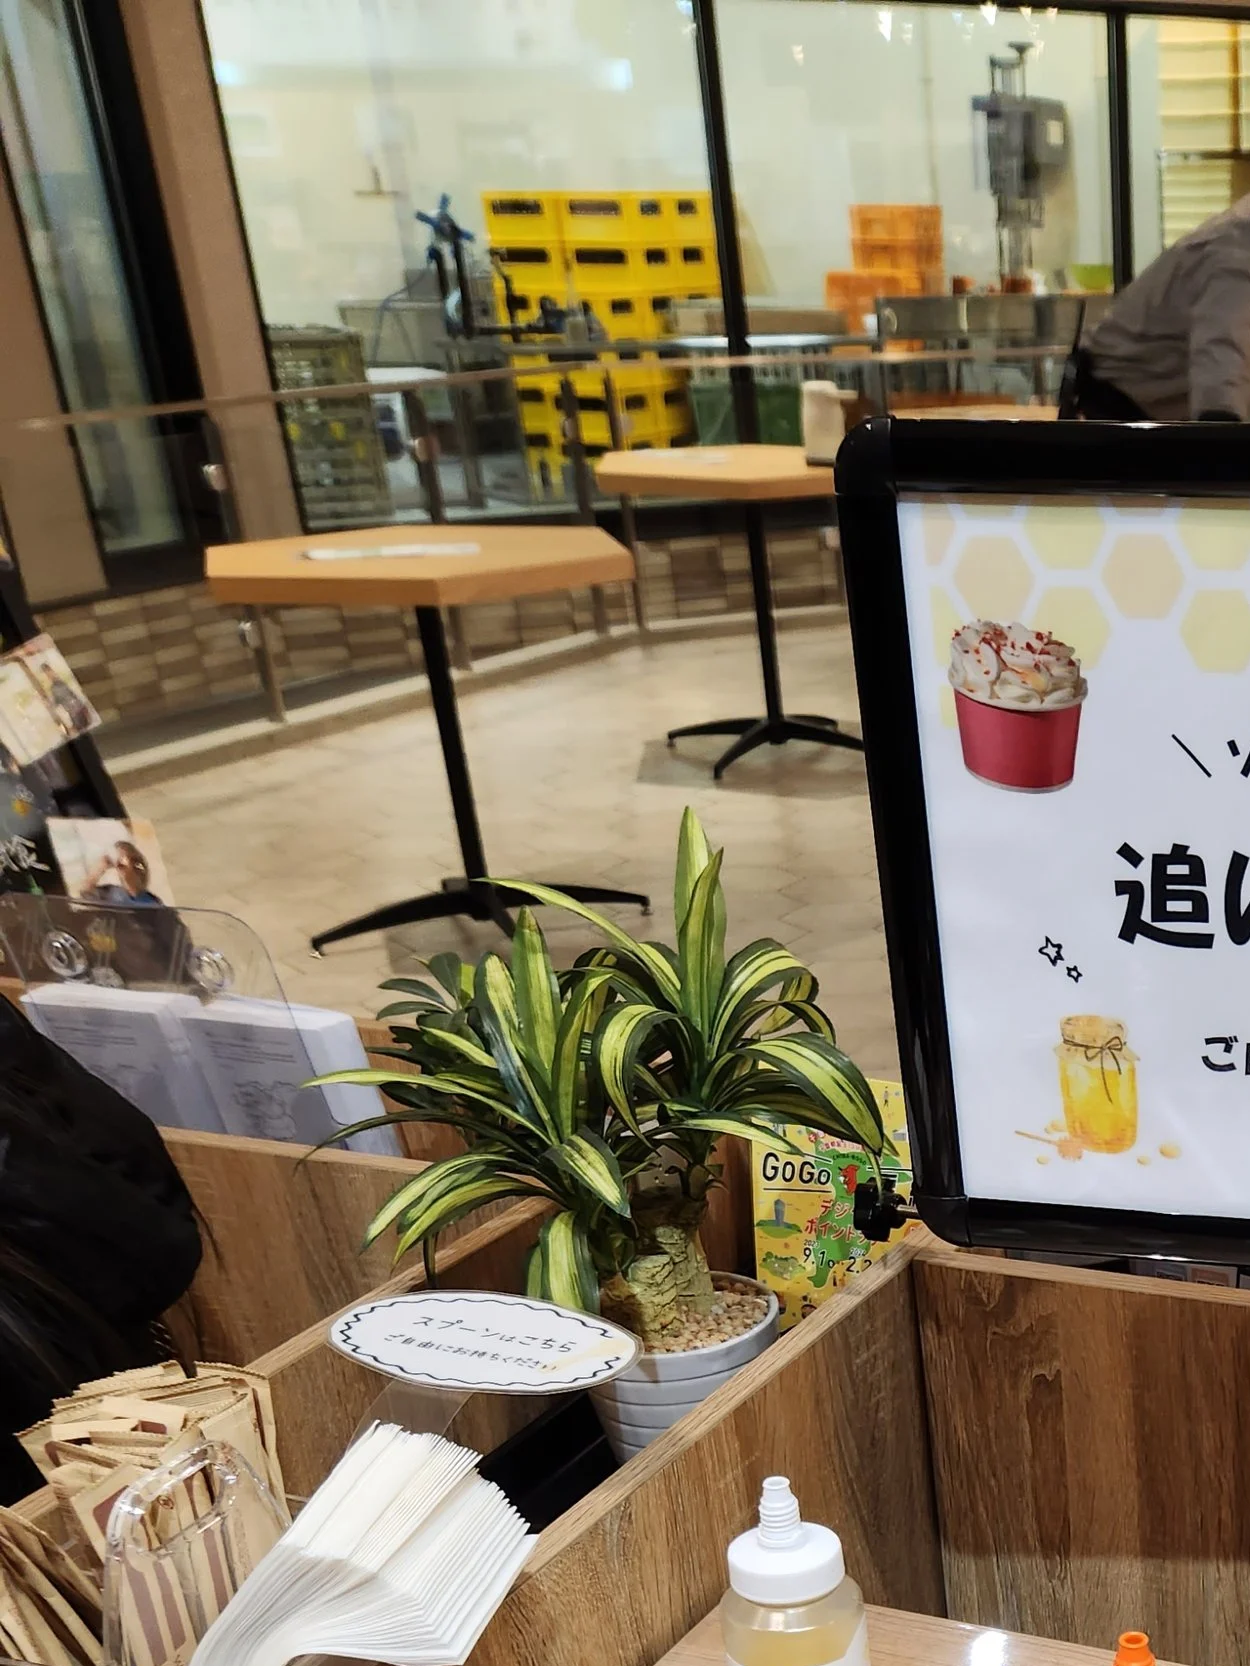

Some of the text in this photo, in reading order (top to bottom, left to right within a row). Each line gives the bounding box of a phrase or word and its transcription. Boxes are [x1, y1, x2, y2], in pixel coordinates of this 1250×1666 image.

[820, 1198, 855, 1218] デジ
[412, 1316, 578, 1353] スプーンはこちら
